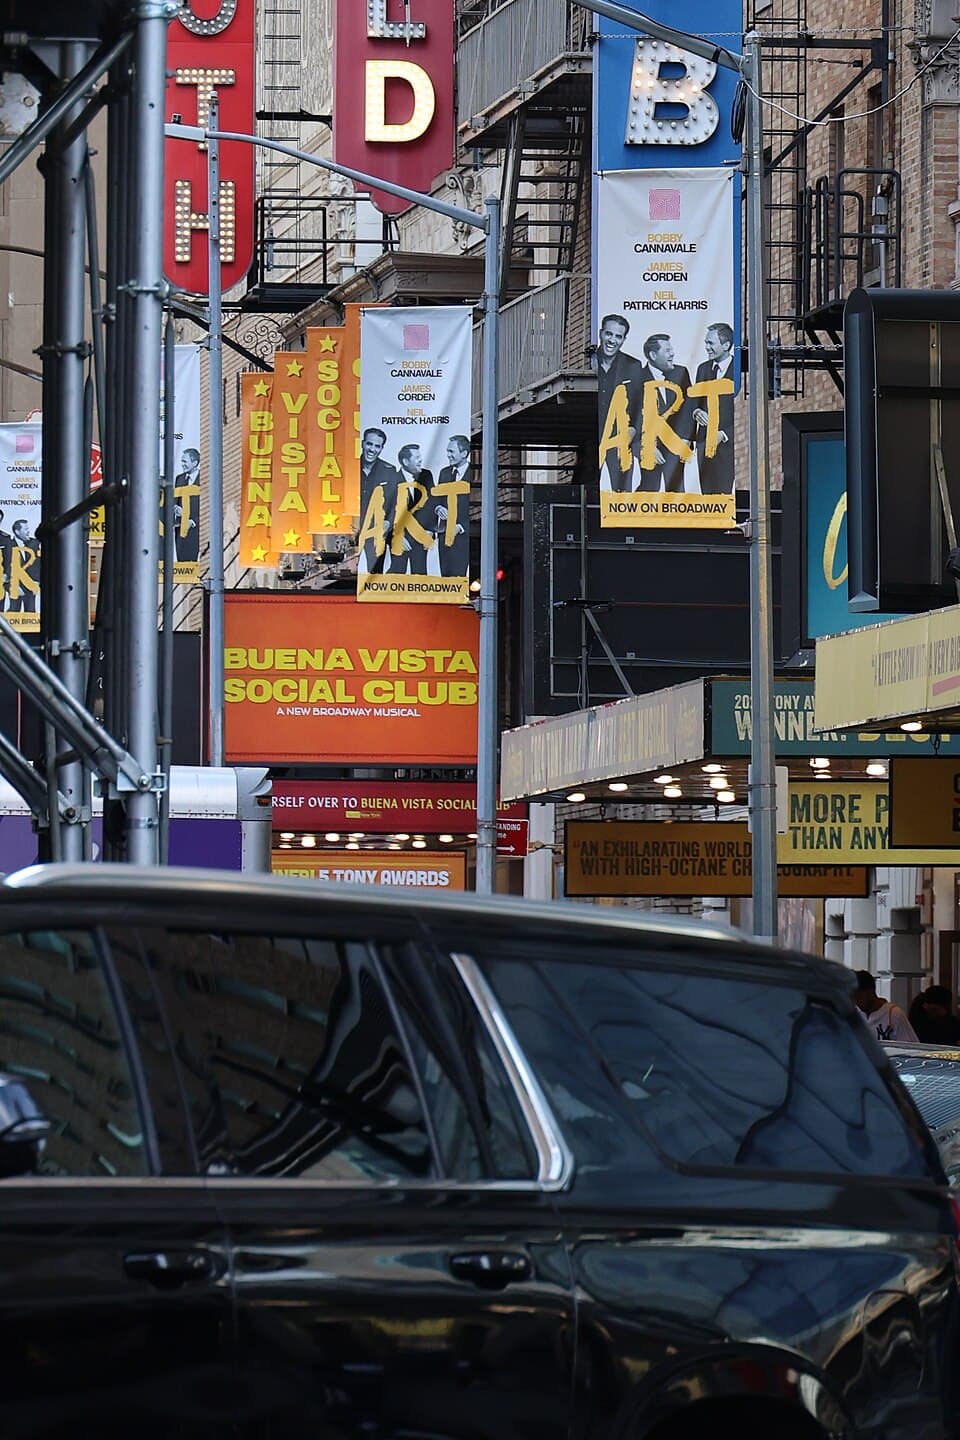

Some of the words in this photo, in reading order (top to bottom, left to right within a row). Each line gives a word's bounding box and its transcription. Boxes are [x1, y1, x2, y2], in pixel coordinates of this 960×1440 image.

[647, 233, 683, 243] BOBBY
[634, 243, 697, 253] CANNAVALE
[647, 262, 684, 272] JAMES
[642, 272, 688, 282] CORDEN
[653, 291, 677, 300] NEIL
[623, 301, 667, 311] PATRICK
[668, 300, 708, 310] HARRIS
[401, 361, 432, 369] BOBBY
[390, 369, 443, 378] CANNAVALE
[401, 385, 432, 393] JAMES
[397, 393, 436, 402] CORDEN
[407, 409, 426, 417] NEIL
[381, 417, 418, 425] PATRICK
[419, 416, 450, 424] HARRIS
[599, 378, 735, 473] ART
[316, 359, 343, 503] SOCIAL
[278, 391, 309, 514] VISTA
[246, 410, 274, 528] BUENA
[609, 503, 637, 513] NOW
[640, 503, 658, 513] ON
[662, 503, 727, 514] BROADWAY
[359, 480, 471, 558] ART
[364, 582, 387, 591] NOW
[390, 583, 405, 592] ON
[407, 583, 462, 593] BROADWAY
[223, 647, 354, 671] BUENA
[357, 648, 479, 674] VISTA
[223, 678, 356, 704] SOCIAL
[362, 679, 478, 706] CLUB
[276, 707, 285, 716] A
[286, 707, 311, 716] NEW
[312, 707, 372, 717] BROADWAY
[373, 708, 421, 717] MUSICAL
[271, 796, 305, 808] RSELF
[308, 796, 339, 809] OVER
[342, 796, 358, 809] TO
[361, 797, 398, 809] BUENA
[401, 798, 434, 810] VISTA
[437, 798, 477, 810] SOCIAL
[790, 794, 860, 823] MORE
[496, 823, 521, 831] TANDING
[790, 827, 842, 850] THAN
[604, 841, 700, 857] EXHILARATING
[580, 859, 619, 876] WITH
[625, 859, 727, 876] HIGH-OCTANE
[319, 870, 329, 881] 5
[332, 870, 378, 885] TONY
[380, 870, 450, 887] AWARDS
